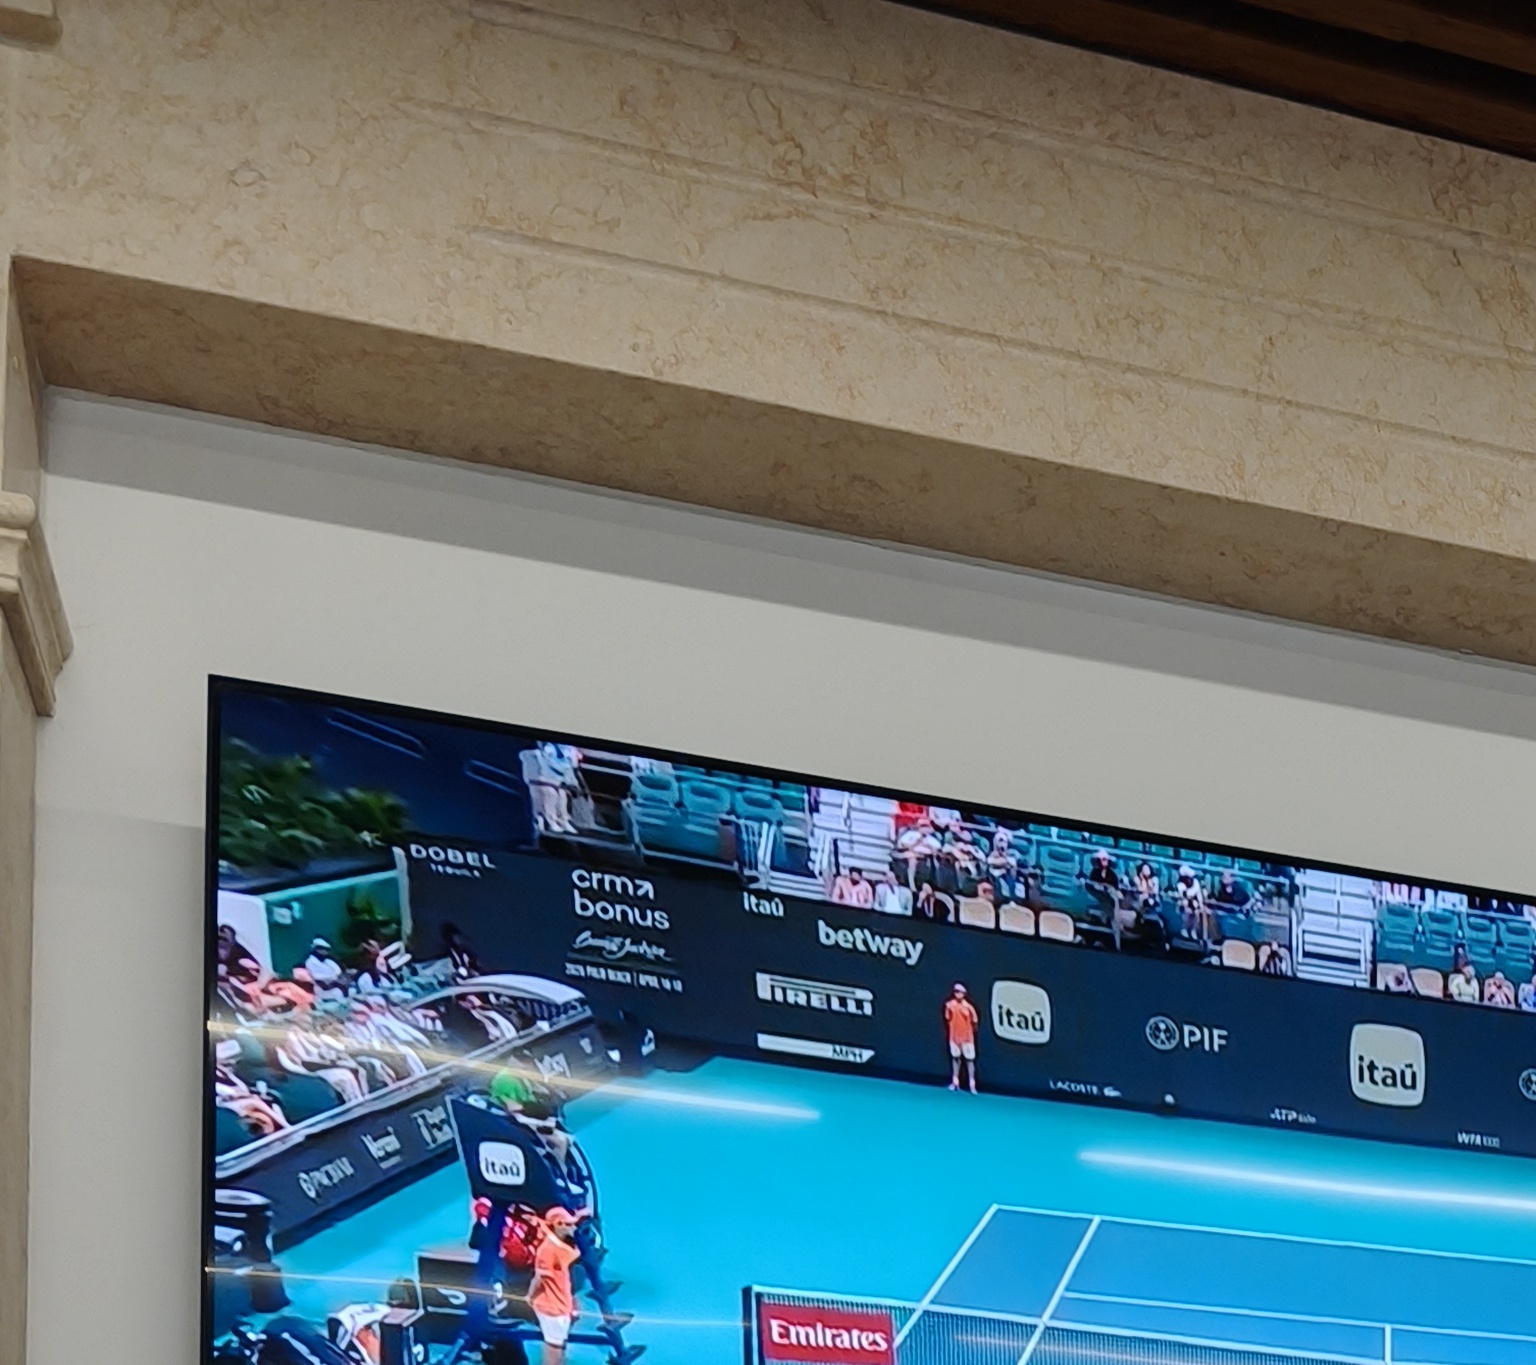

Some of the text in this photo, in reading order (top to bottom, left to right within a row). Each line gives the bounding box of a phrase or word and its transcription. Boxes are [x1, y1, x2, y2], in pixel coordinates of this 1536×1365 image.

[409, 843, 497, 869] DOBEL
[573, 888, 671, 930] bonus
[816, 918, 924, 967] betway
[756, 971, 873, 1016] PIRELLI
[1183, 1023, 1229, 1053] PIF
[769, 1318, 889, 1352] Emirates
